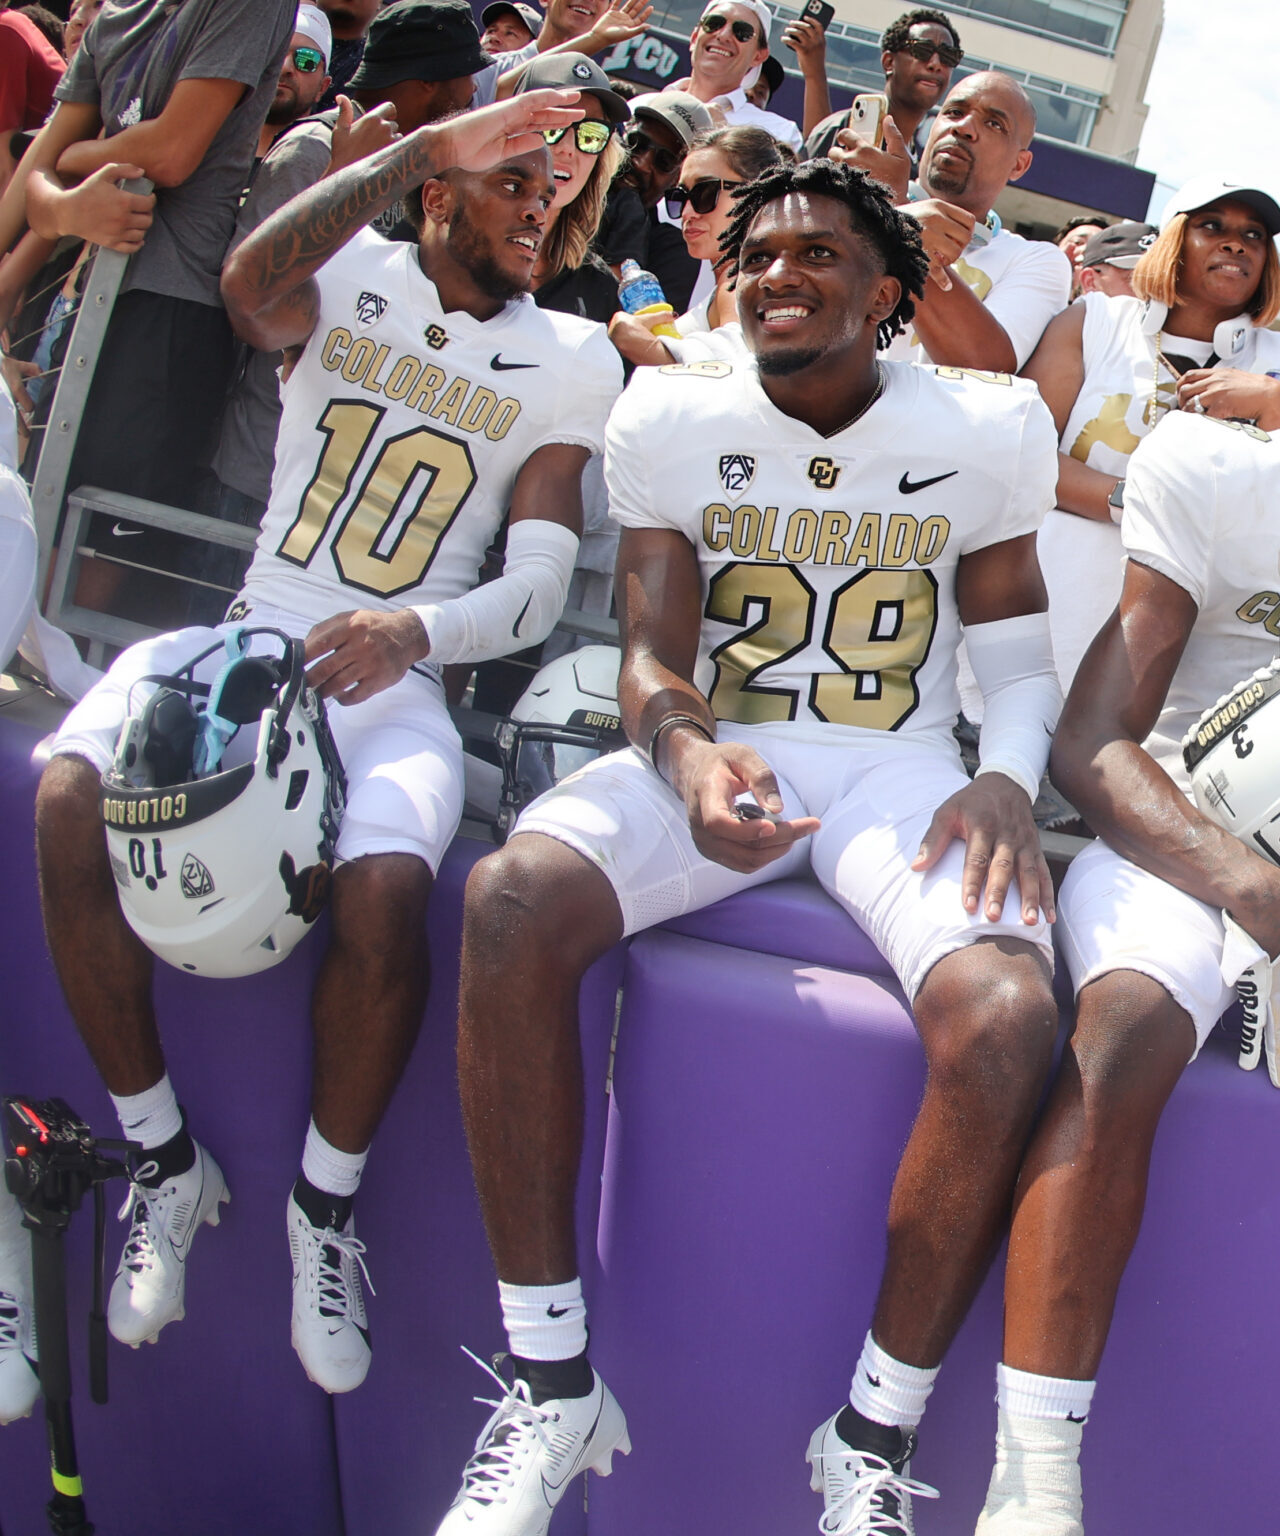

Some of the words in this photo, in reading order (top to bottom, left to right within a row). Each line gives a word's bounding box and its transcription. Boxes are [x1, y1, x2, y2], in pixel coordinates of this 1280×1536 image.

[601, 33, 680, 79] TCU
[356, 291, 388, 320] PAC
[358, 307, 376, 324] 12
[424, 323, 450, 350] CU
[321, 326, 522, 442] COLORADO
[717, 453, 756, 483] PAC
[725, 473, 744, 491] 12
[807, 455, 844, 489] CU
[276, 398, 478, 599] 10
[702, 503, 951, 568] COLORADO
[703, 561, 939, 732] 29
[584, 711, 620, 730] BUFFS
[1196, 682, 1265, 747] COLORADO
[1231, 723, 1254, 760] 3
[103, 793, 188, 825] COLORADO
[128, 837, 168, 880] 10
[184, 862, 201, 880] 12
